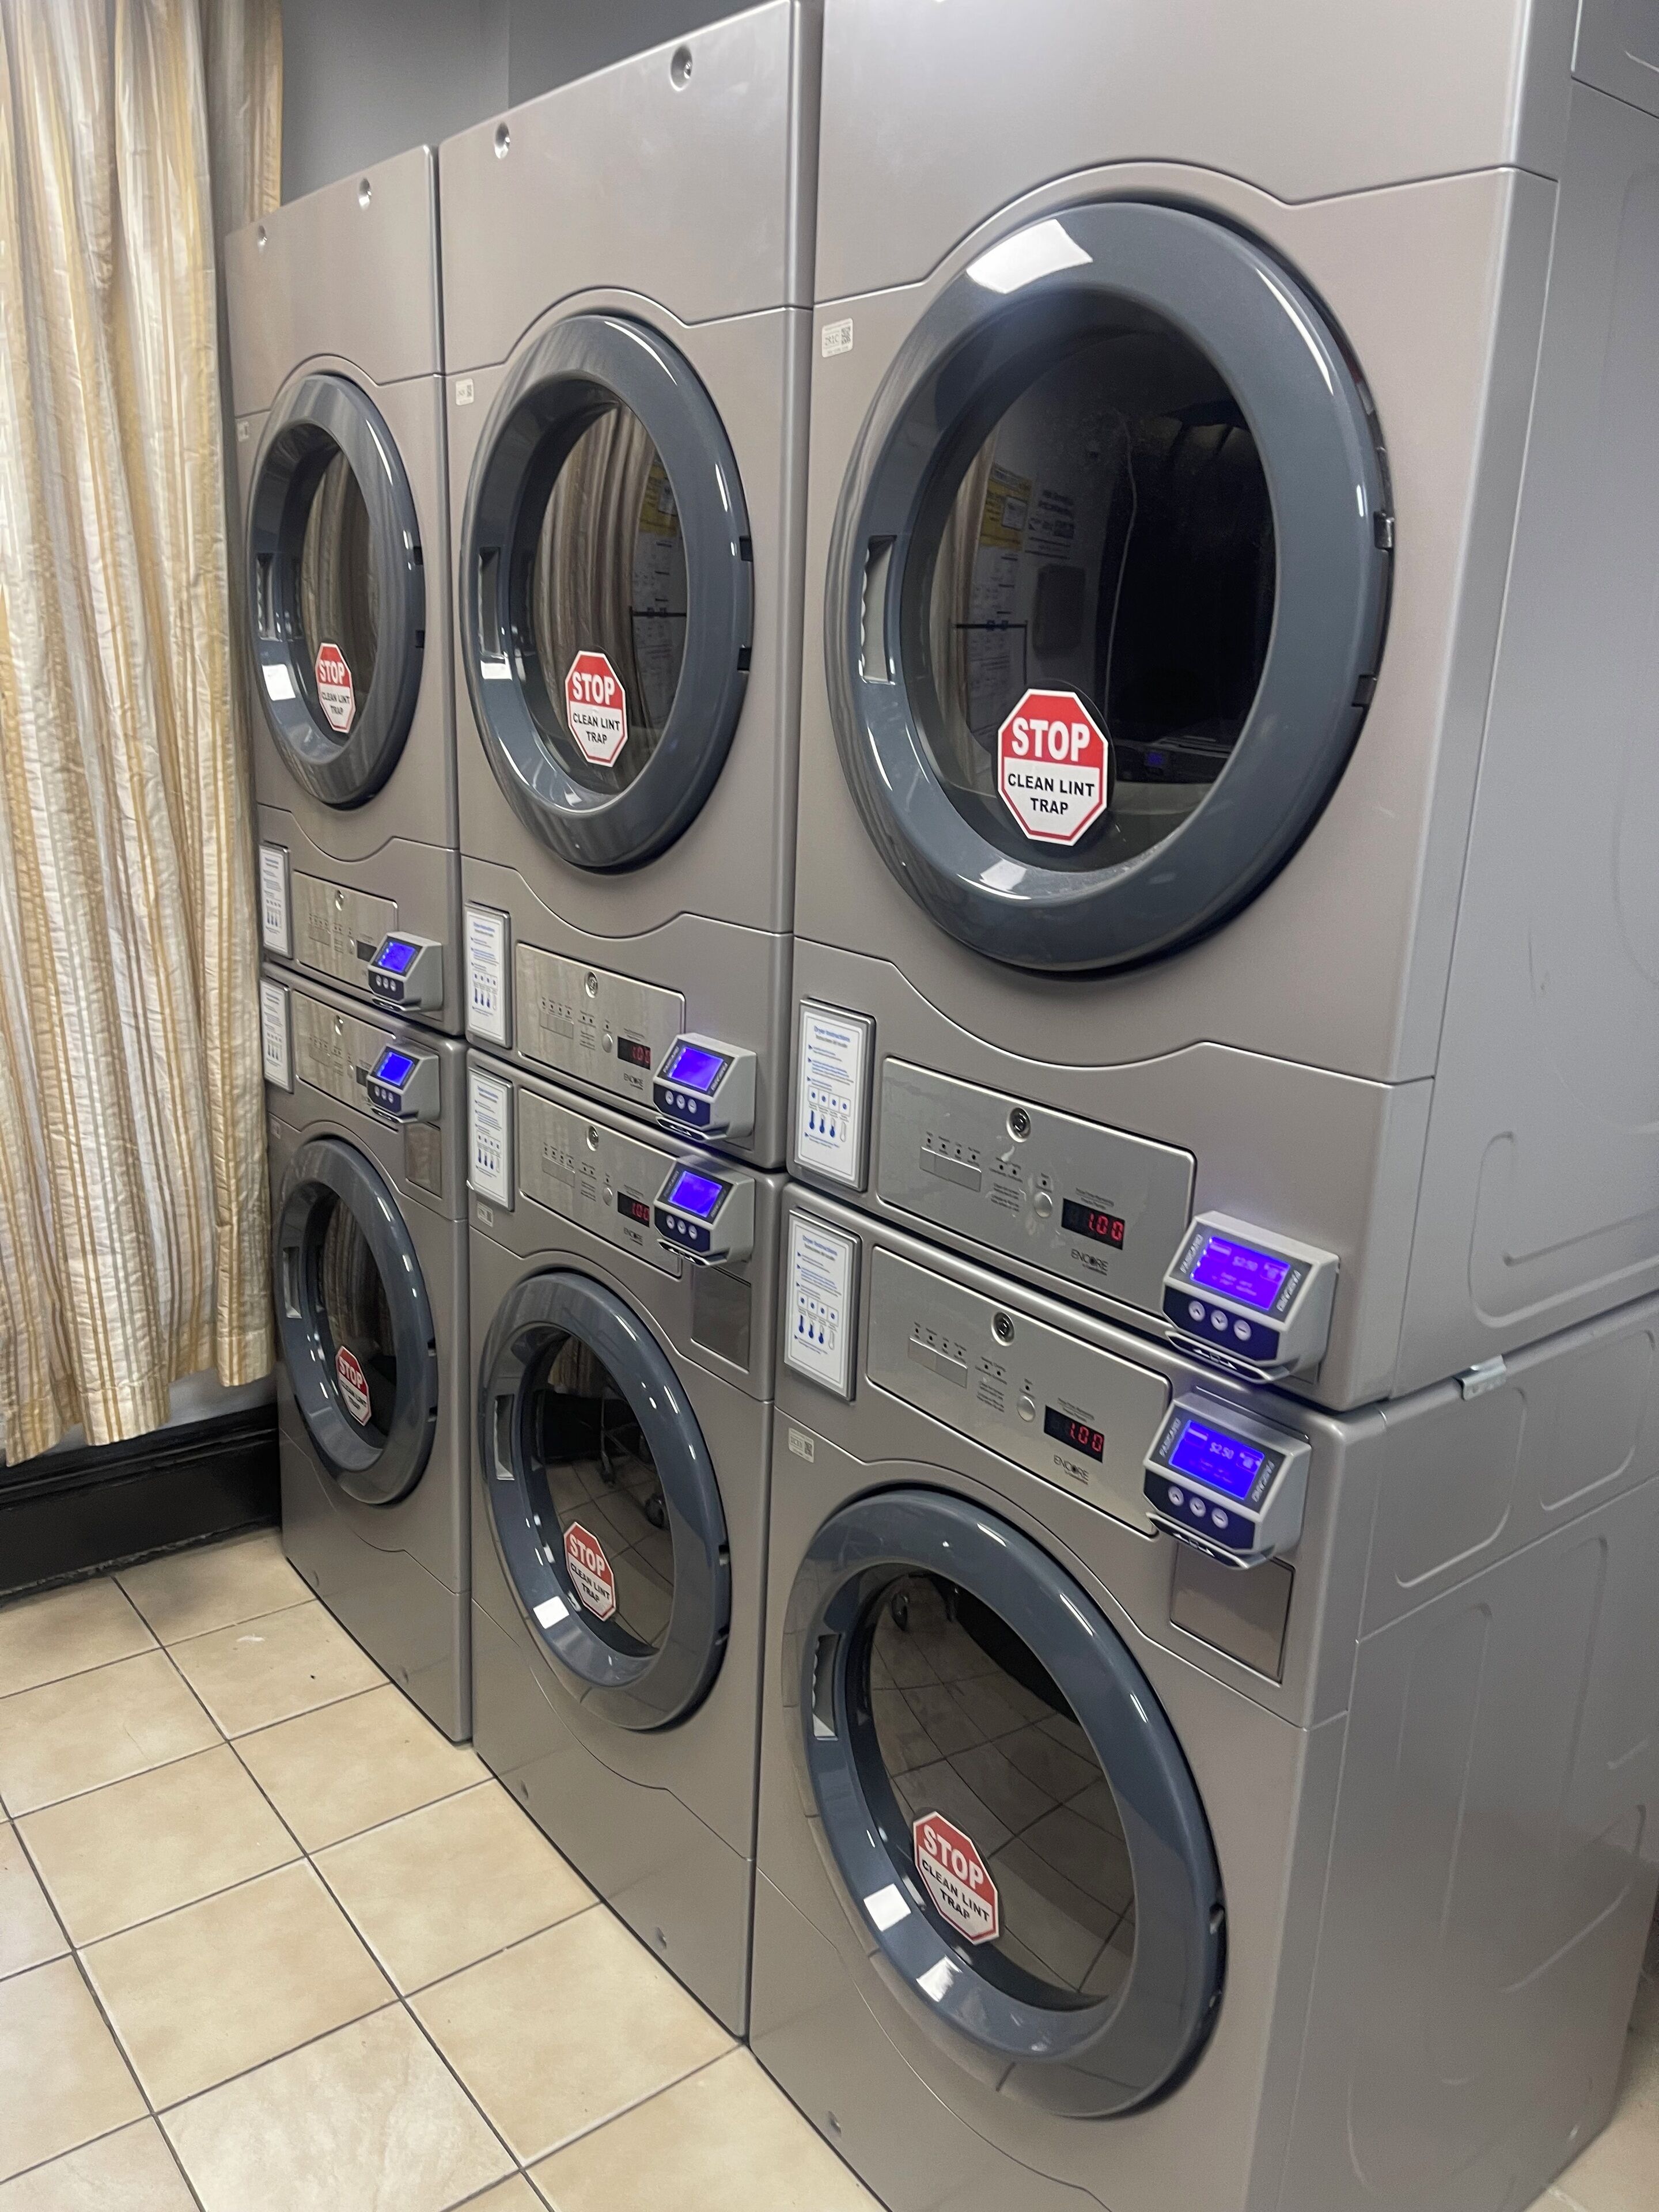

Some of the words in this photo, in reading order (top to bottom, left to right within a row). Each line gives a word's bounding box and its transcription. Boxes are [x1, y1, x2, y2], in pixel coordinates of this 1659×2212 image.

[319, 660, 345, 684] STOP
[321, 691, 338, 702] CLEAN
[571, 671, 615, 706] STOP
[573, 713, 599, 727] CLEAN
[601, 718, 620, 731] LINT
[586, 731, 607, 744] TRAP
[1011, 717, 1090, 762] STOP
[1007, 773, 1054, 792] CLEAN
[1060, 780, 1095, 797] LINT
[1030, 797, 1069, 815] TRAP
[1071, 1248, 1109, 1271] ENCORE
[339, 1355, 363, 1389] STOP
[1054, 1454, 1089, 1482] ENCORE
[569, 1533, 605, 1578] STOP
[570, 1563, 592, 1586] CLEAN
[593, 1582, 611, 1601] LINT
[581, 1582, 600, 1603] TRAP
[923, 1824, 984, 1890] STOP
[922, 1858, 958, 1898] CLEAN
[961, 1890, 990, 1922] LINT
[940, 1888, 970, 1921] TRAP
